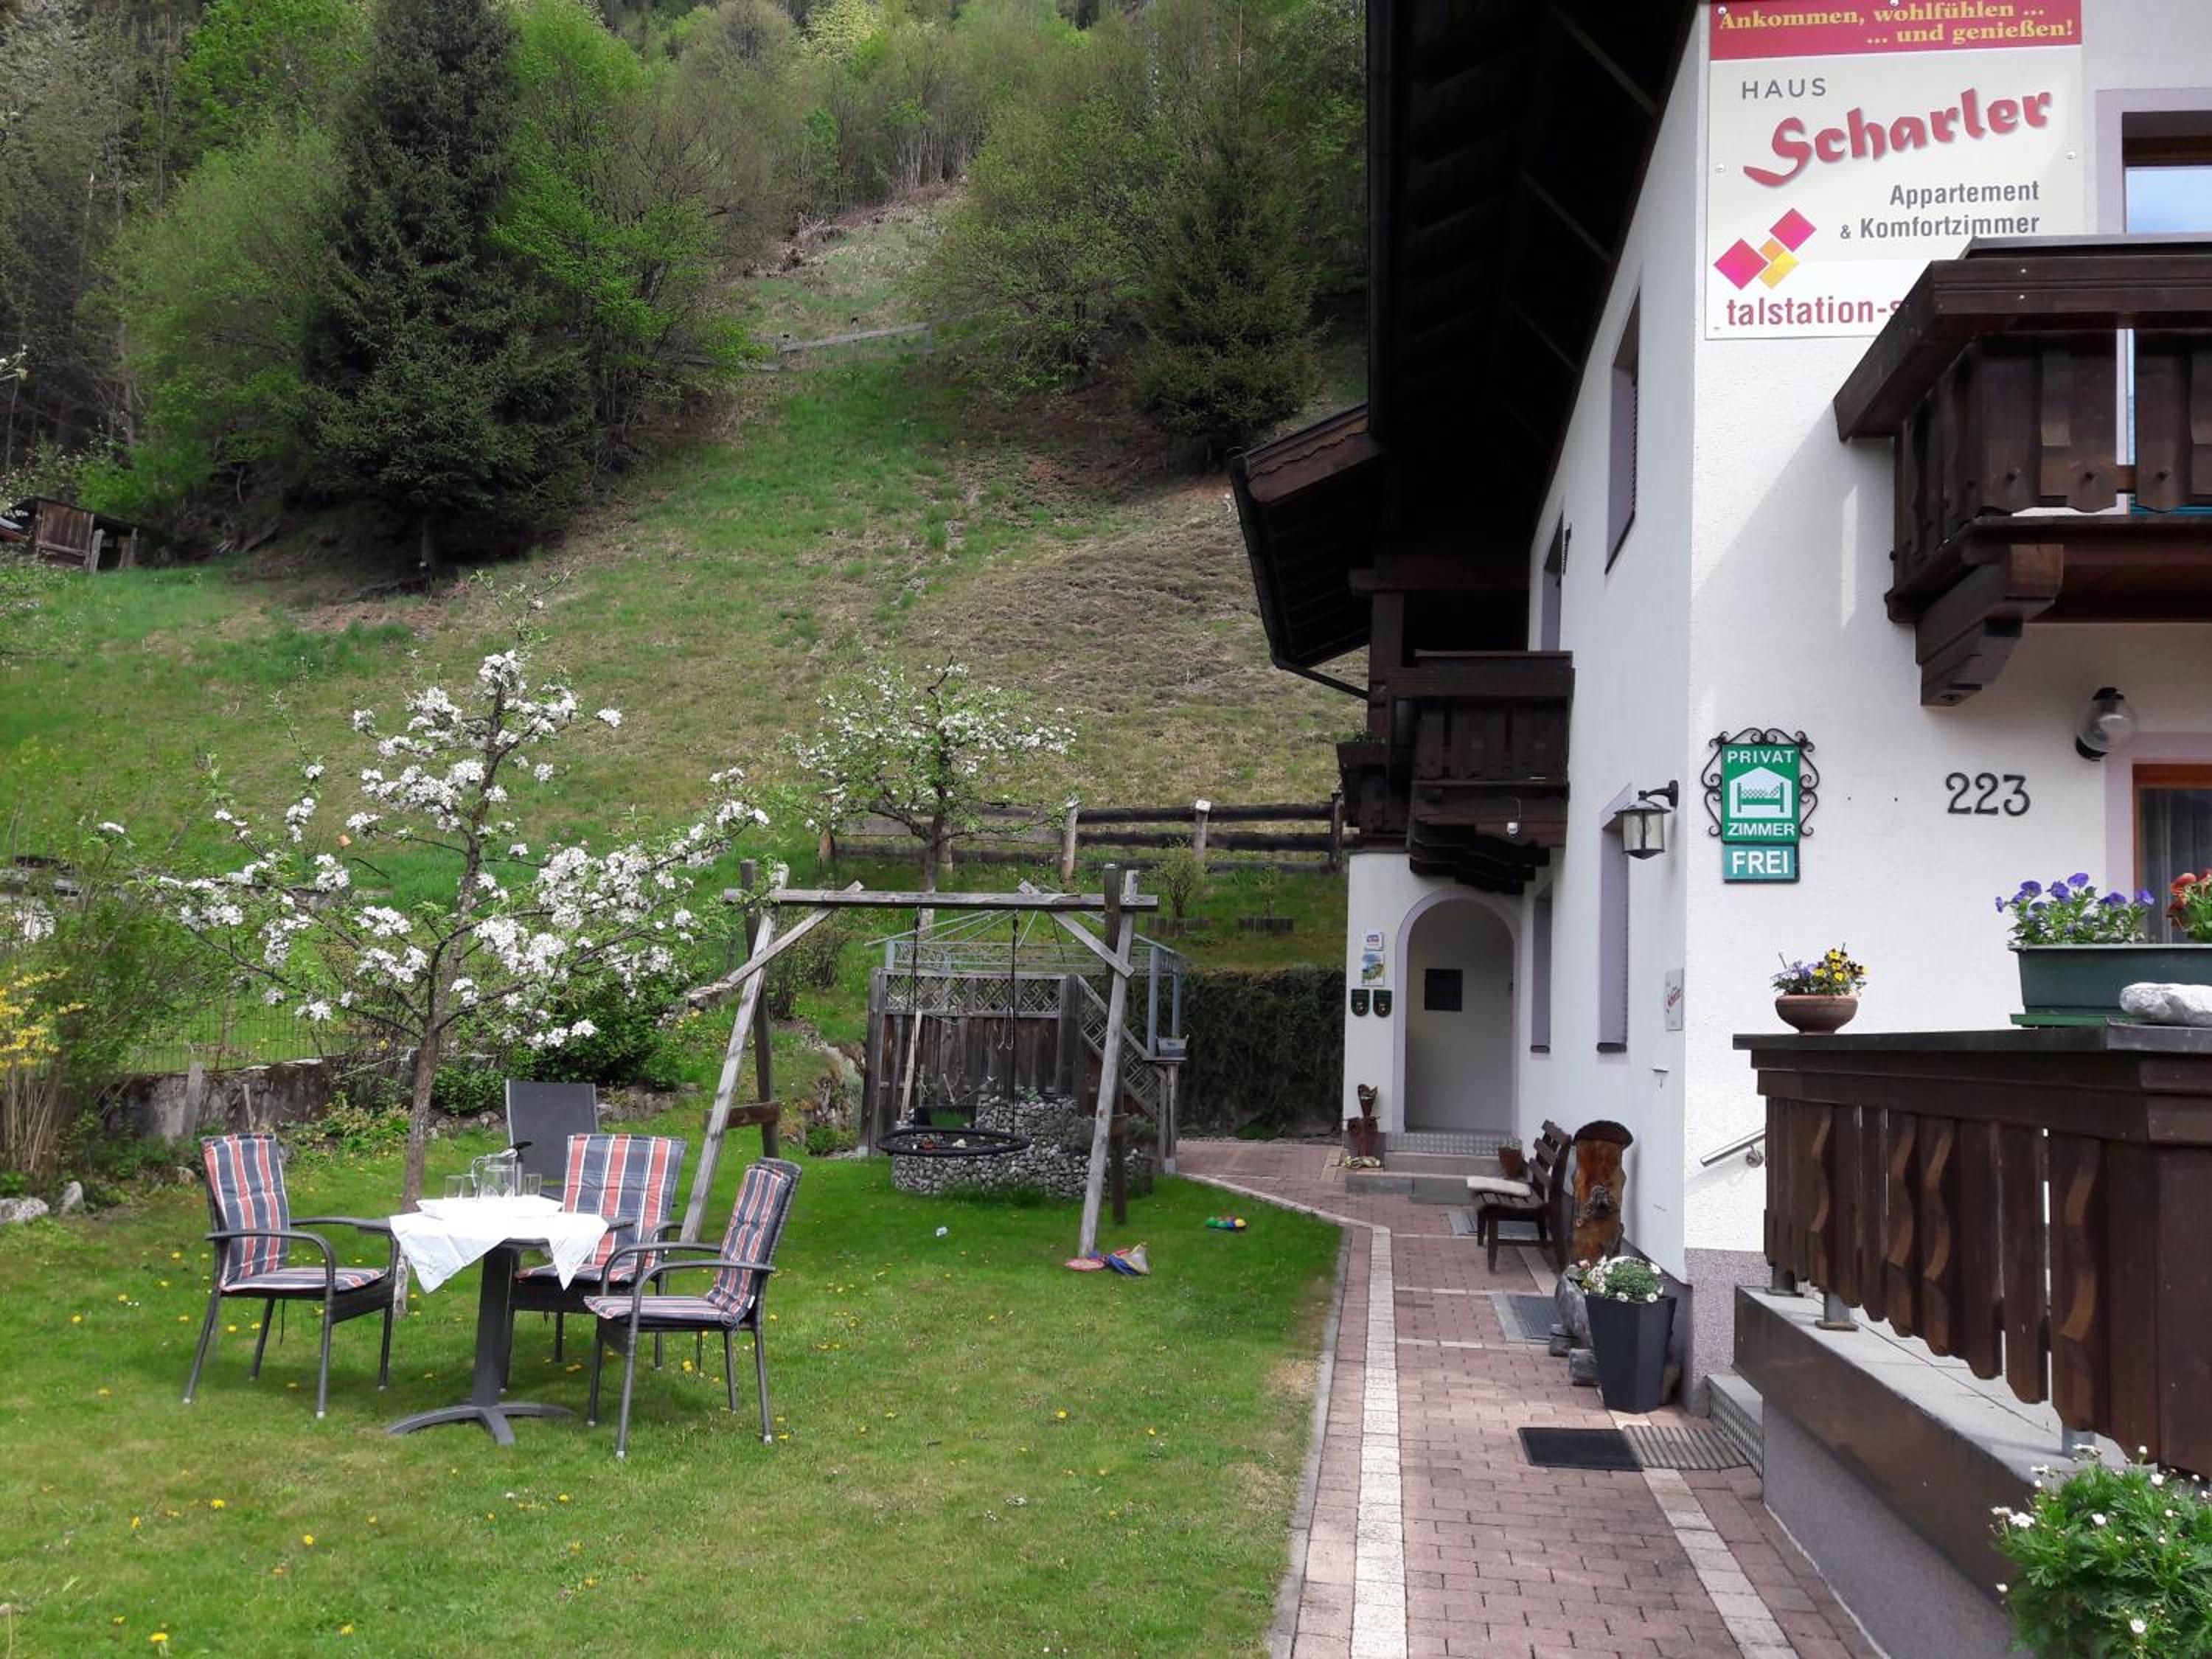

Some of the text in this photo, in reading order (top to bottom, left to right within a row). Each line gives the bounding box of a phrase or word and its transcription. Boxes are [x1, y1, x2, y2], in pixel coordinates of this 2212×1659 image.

[1719, 10, 1865, 29] Ankommen,
[1874, 1, 2014, 22] wohlfühlen
[1896, 24, 1944, 43] und
[1952, 19, 2073, 46] genießen!
[1741, 77, 1827, 100] HAUS
[1743, 88, 2053, 187] Scharler
[1890, 181, 2039, 209] Appartement
[1840, 214, 2039, 239] & Komfortzimmer
[1728, 750, 1794, 763] PRIVAT
[1945, 772, 2031, 817] 223
[1728, 823, 1795, 836] ZIMMER
[1733, 850, 1788, 874] FREI
